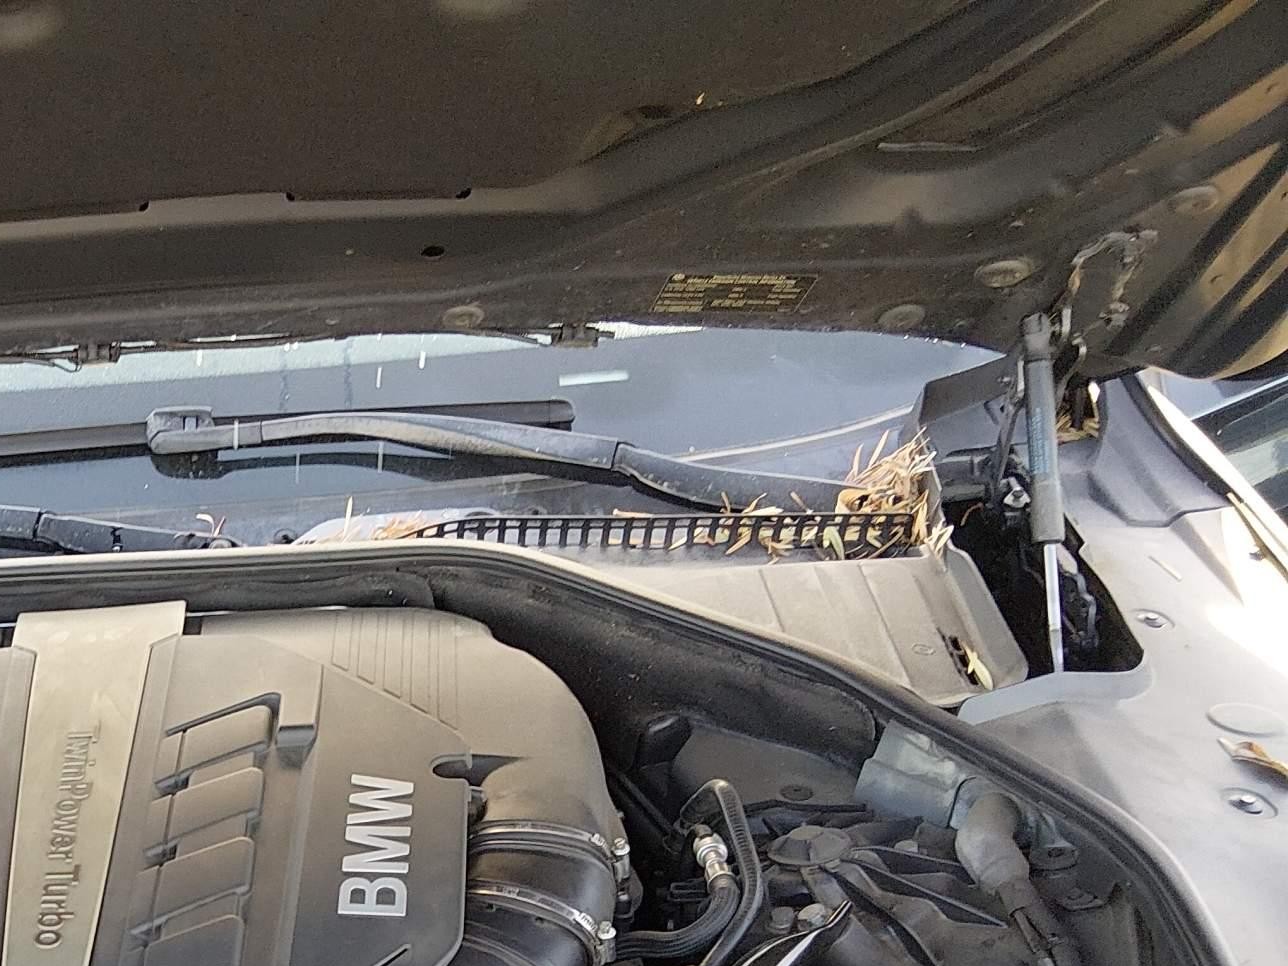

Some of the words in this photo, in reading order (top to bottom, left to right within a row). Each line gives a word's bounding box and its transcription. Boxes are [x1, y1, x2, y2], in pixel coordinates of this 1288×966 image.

[47, 720, 102, 863] TwinPower
[337, 774, 414, 917] BMW
[34, 864, 81, 949] Turbo
